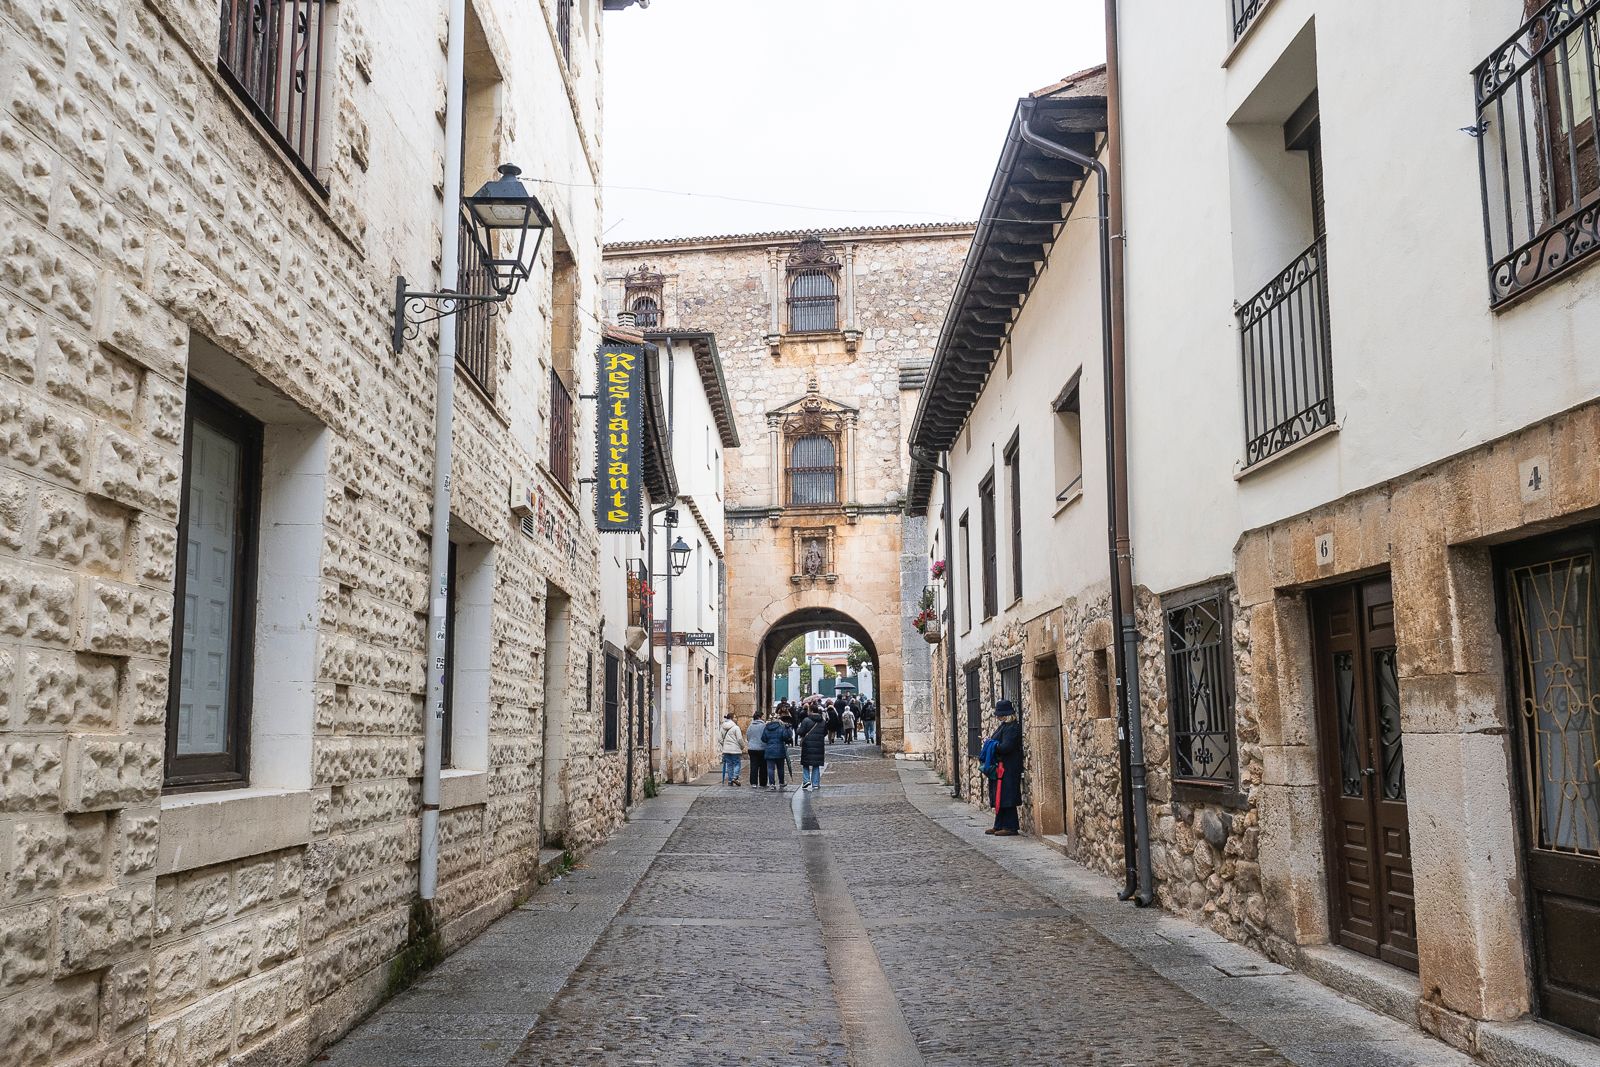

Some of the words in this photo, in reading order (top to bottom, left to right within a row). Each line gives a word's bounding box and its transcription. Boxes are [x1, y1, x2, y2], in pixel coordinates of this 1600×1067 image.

[603, 352, 636, 523] Restaurante
[1528, 466, 1542, 491] 4
[1320, 539, 1329, 558] 6
